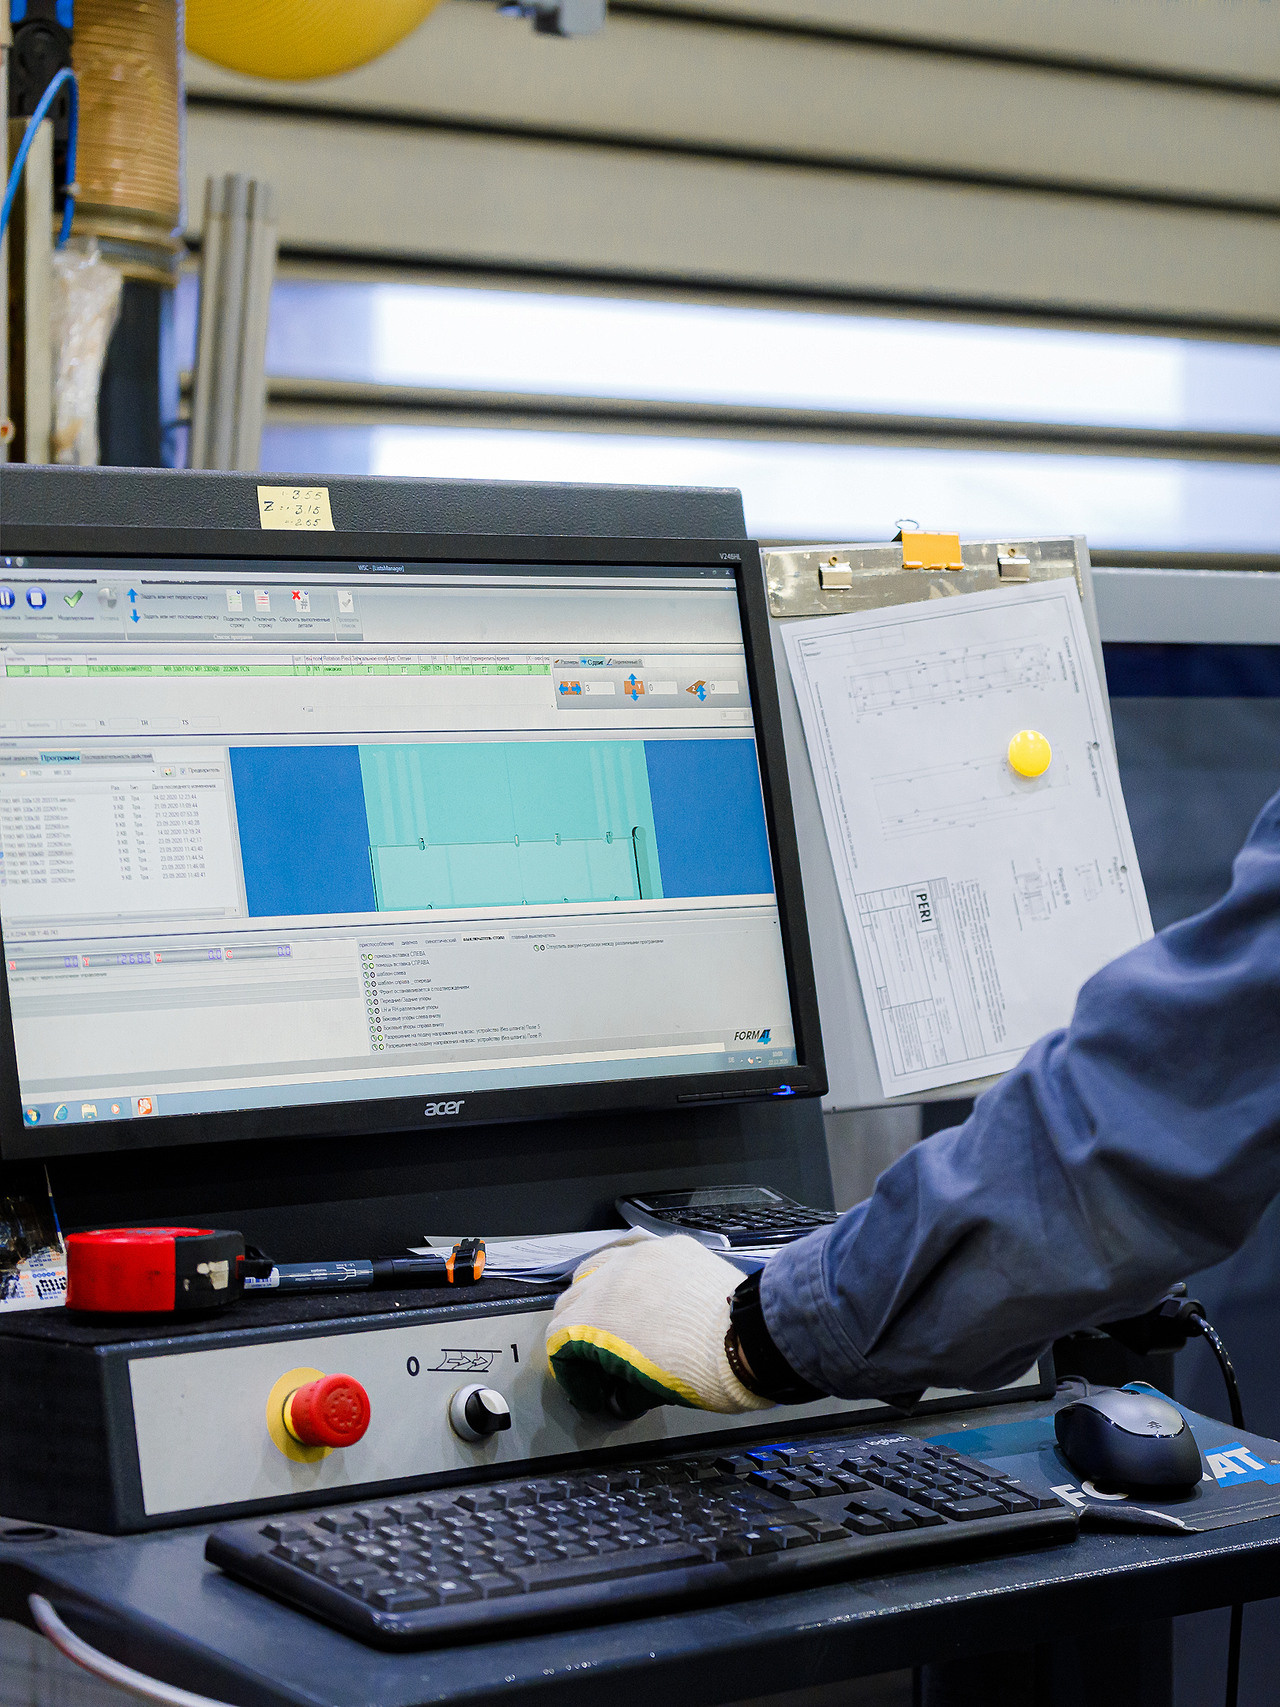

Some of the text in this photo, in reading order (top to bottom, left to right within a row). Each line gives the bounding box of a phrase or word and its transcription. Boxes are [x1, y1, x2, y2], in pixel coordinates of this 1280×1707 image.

[40, 754, 80, 762] Программы
[916, 892, 933, 924] PERI
[424, 1100, 465, 1117] acer
[406, 1356, 420, 1377] 0
